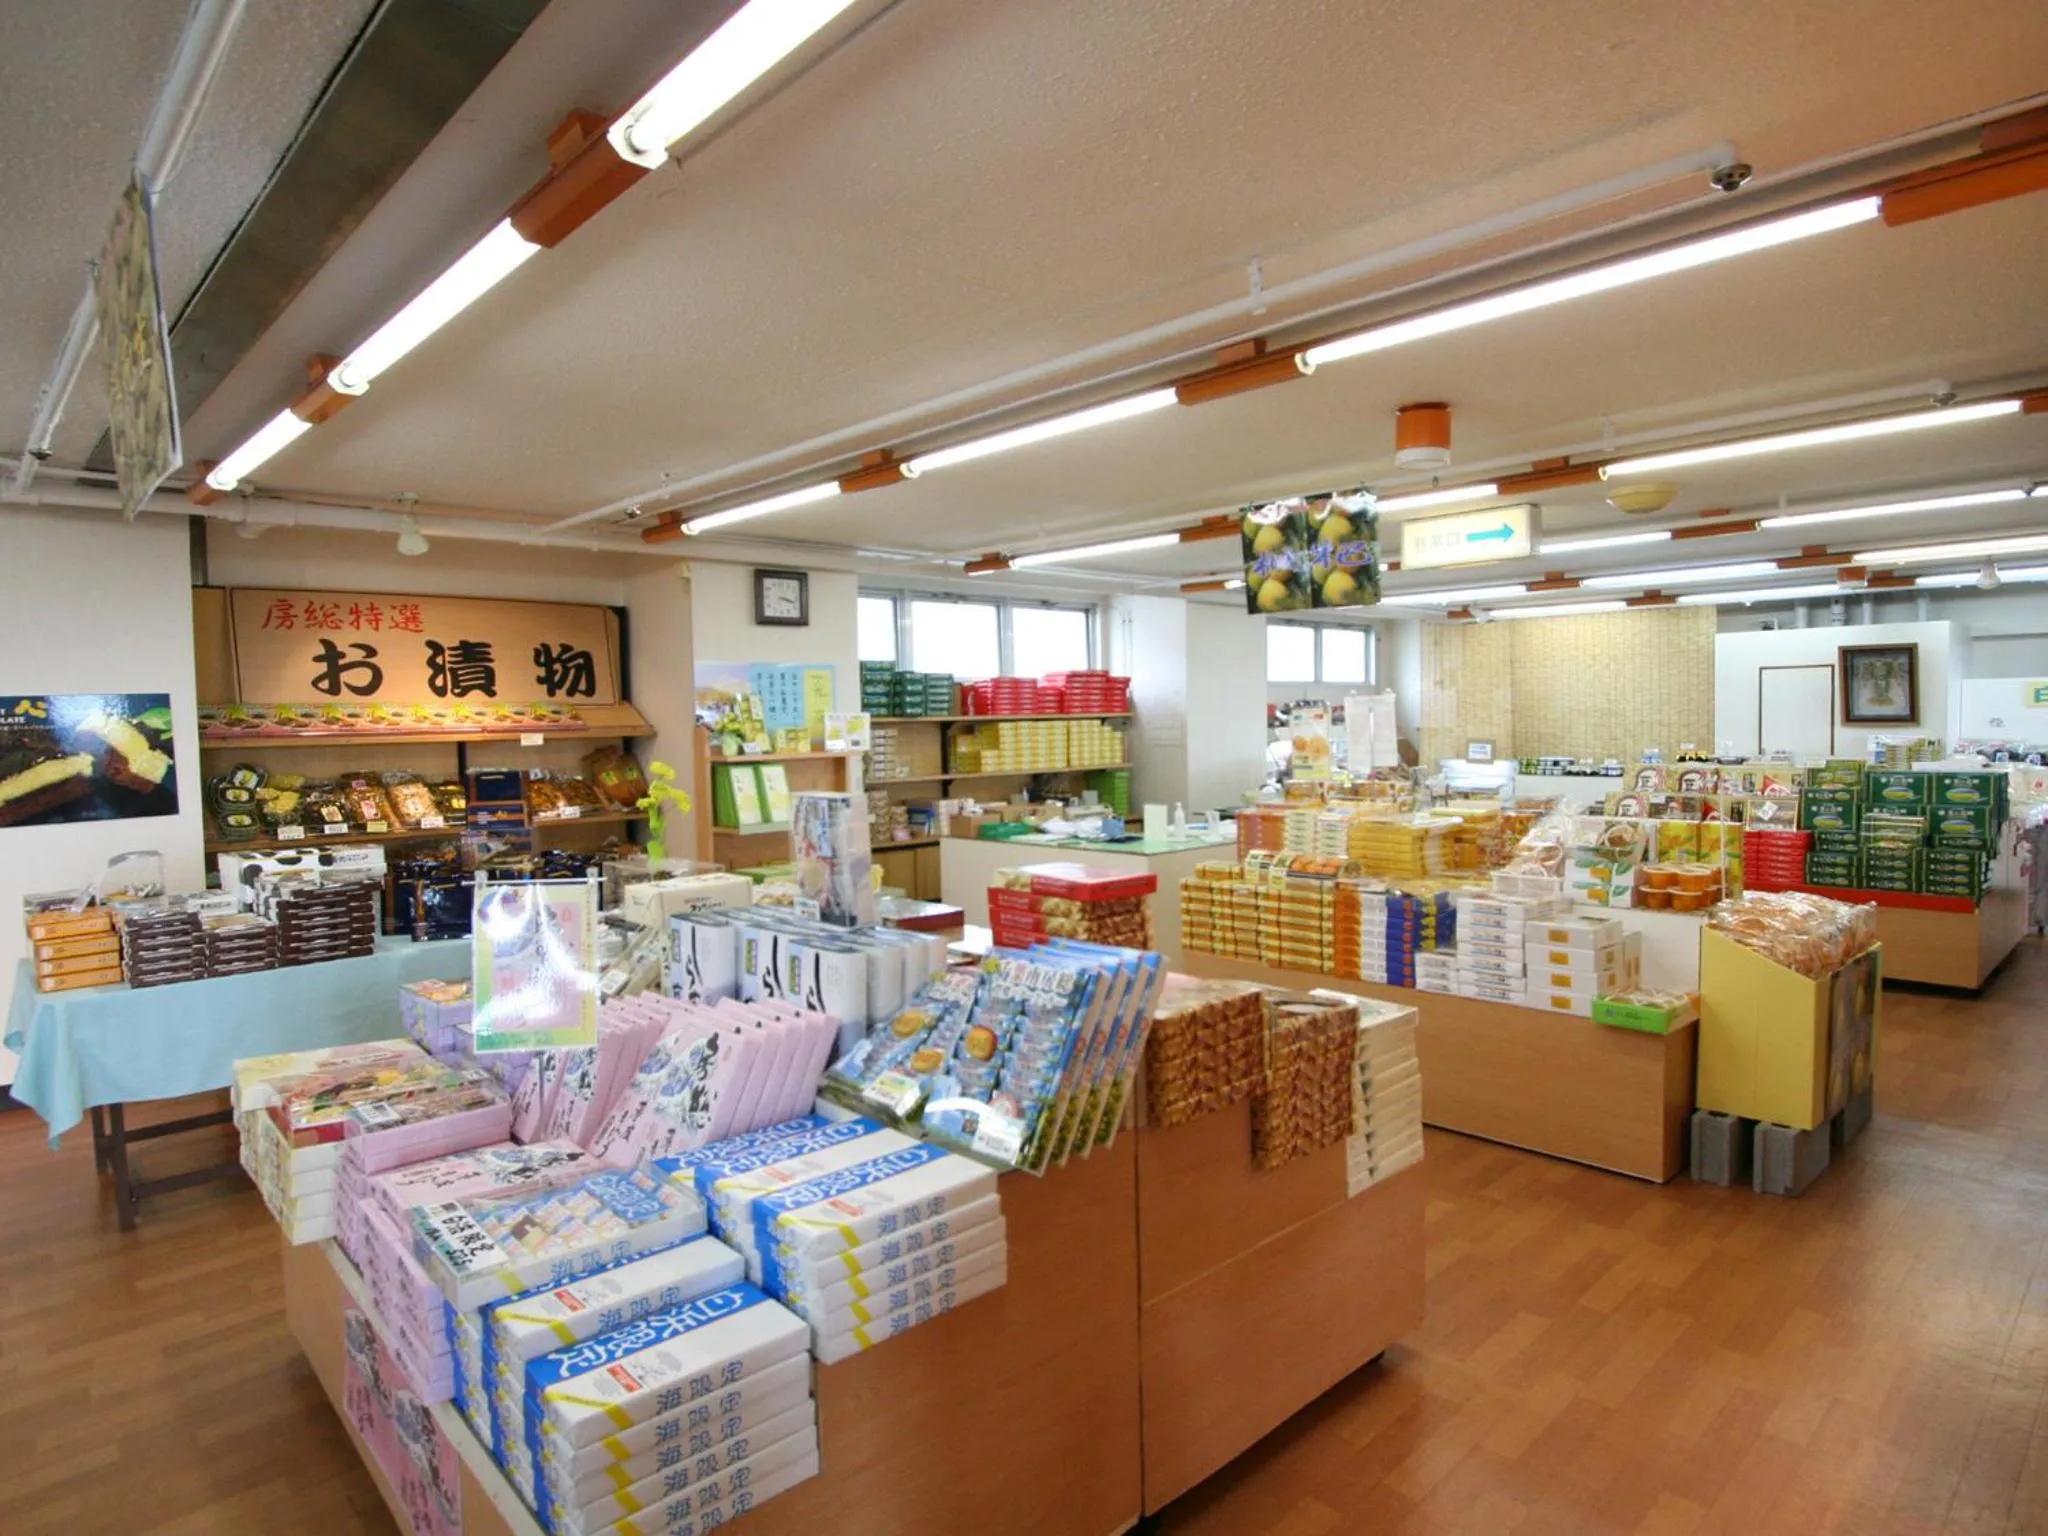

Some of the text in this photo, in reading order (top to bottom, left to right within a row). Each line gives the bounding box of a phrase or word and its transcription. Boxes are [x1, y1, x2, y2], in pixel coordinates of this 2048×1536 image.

[262, 600, 425, 633] 房総特選
[311, 638, 597, 698] お漬物
[547, 1289, 745, 1378] 白浜限定
